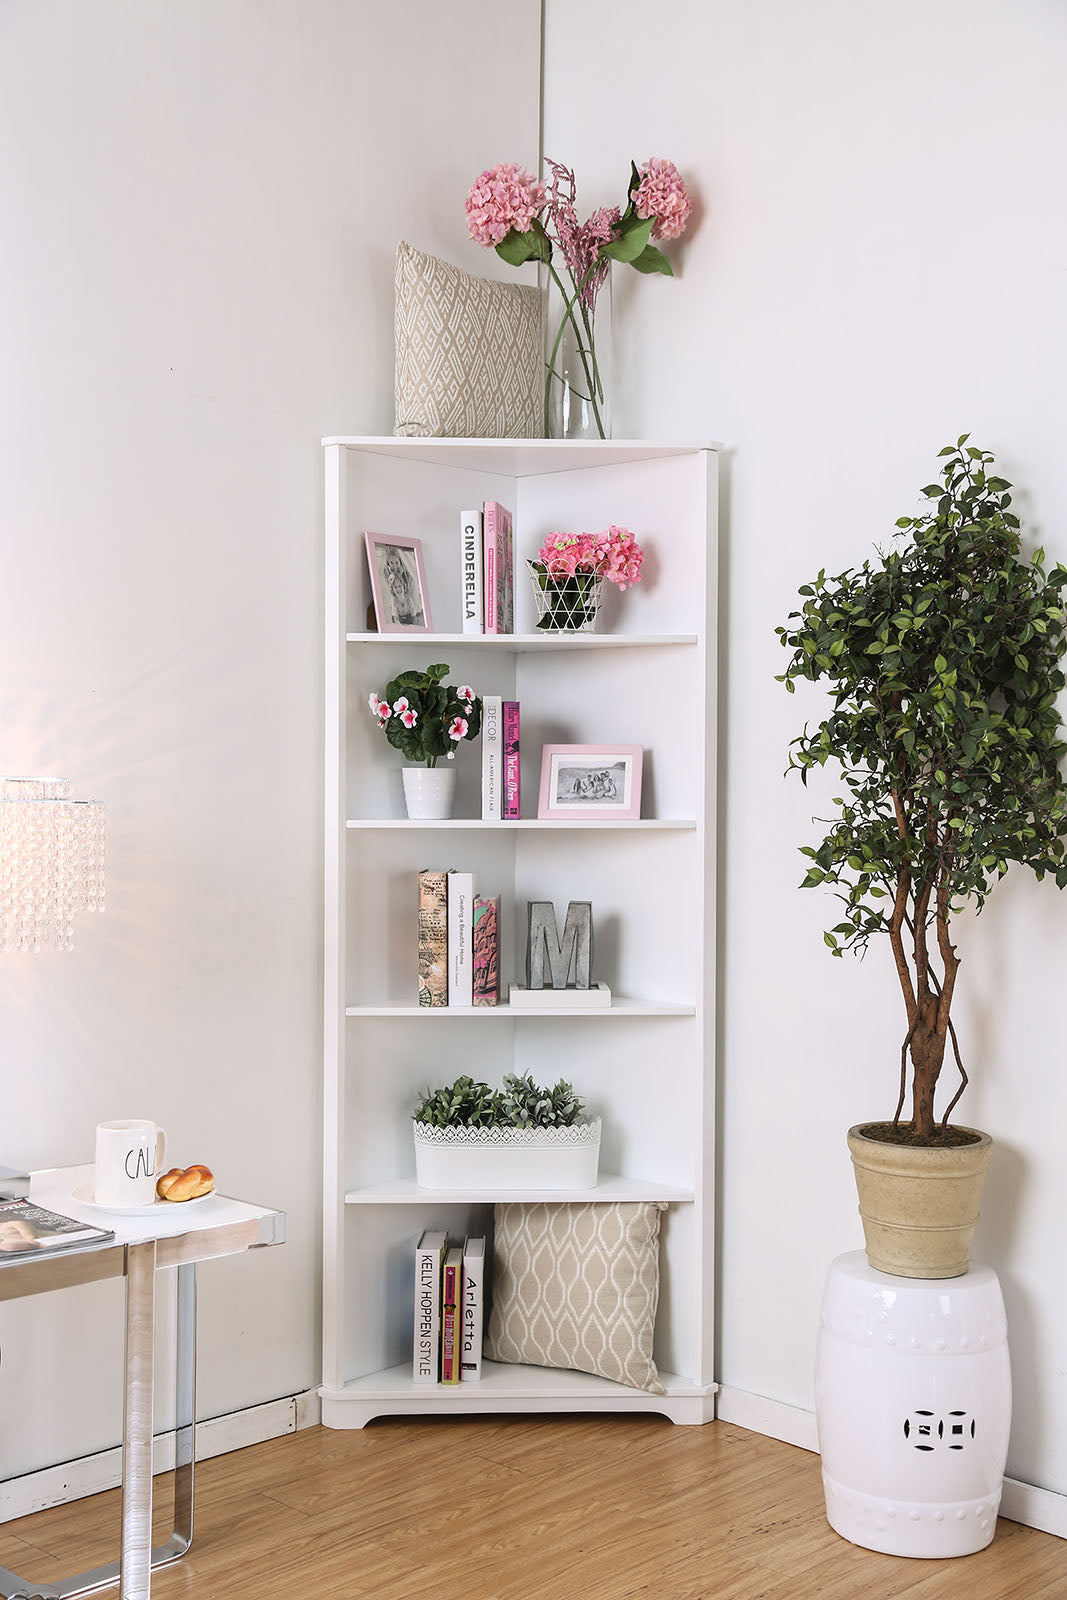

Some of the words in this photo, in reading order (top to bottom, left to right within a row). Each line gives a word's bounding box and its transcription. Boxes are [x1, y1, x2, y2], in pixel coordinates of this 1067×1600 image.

[464, 525, 476, 619] CINDERELLA
[487, 708, 497, 742] DECOR
[526, 900, 592, 990] M
[421, 1255, 433, 1289] KELLY
[420, 1291, 433, 1338] HOPPEN
[463, 1277, 477, 1352] Arletta
[419, 1341, 432, 1376] STYLE
